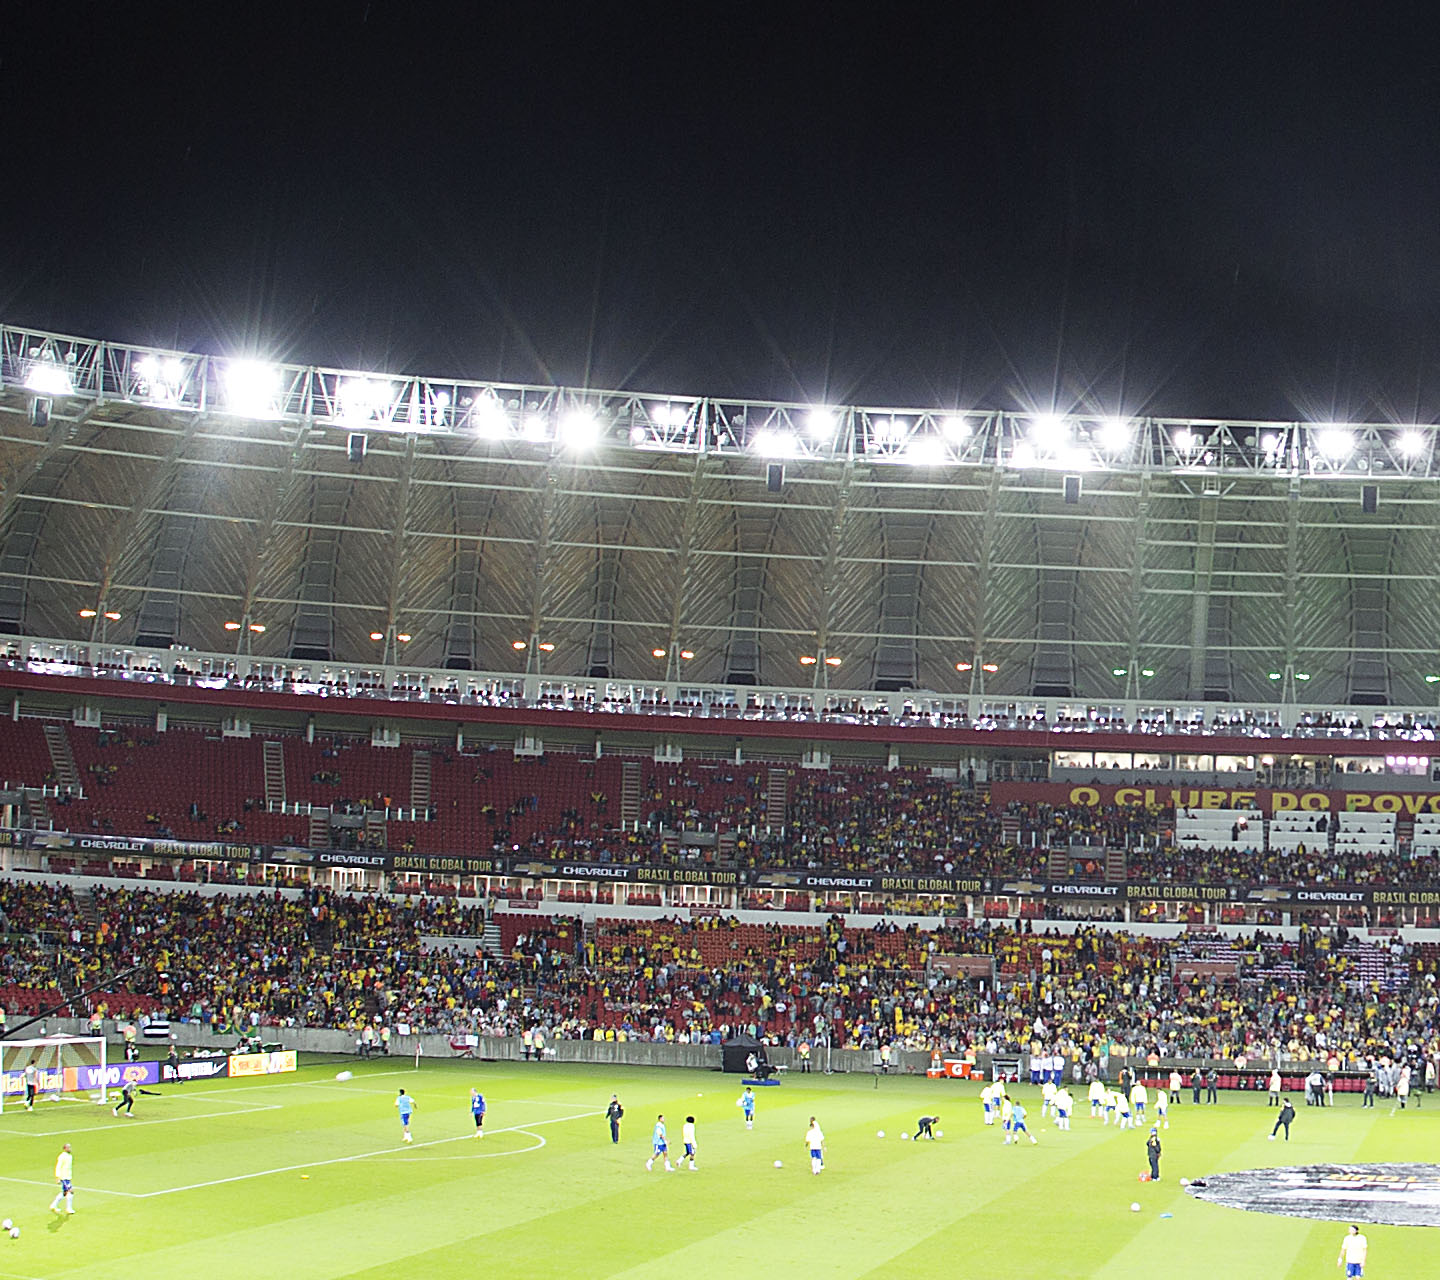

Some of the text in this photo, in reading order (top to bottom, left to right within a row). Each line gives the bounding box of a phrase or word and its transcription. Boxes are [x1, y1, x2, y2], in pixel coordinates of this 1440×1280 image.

[1070, 787, 1099, 805] O
[1114, 788, 1256, 808] CLUBE
[1273, 792, 1330, 810] DO
[81, 840, 250, 858] CHEVROLET BRASIL GLOBAL TOUR
[320, 855, 492, 872] CHEVROLET BRASIL GLOBAL TOUR
[563, 867, 736, 883] CHEVROLET BRASIL GLOBAL TOUR
[807, 877, 980, 891] CHEVROLET BRASIL GLOBAL TOUR
[1052, 885, 1226, 899] CHEVROLET BRASIL GLOBAL TOUR
[1298, 892, 1364, 901] CHEVROLET
[1373, 892, 1405, 903] BRASIL
